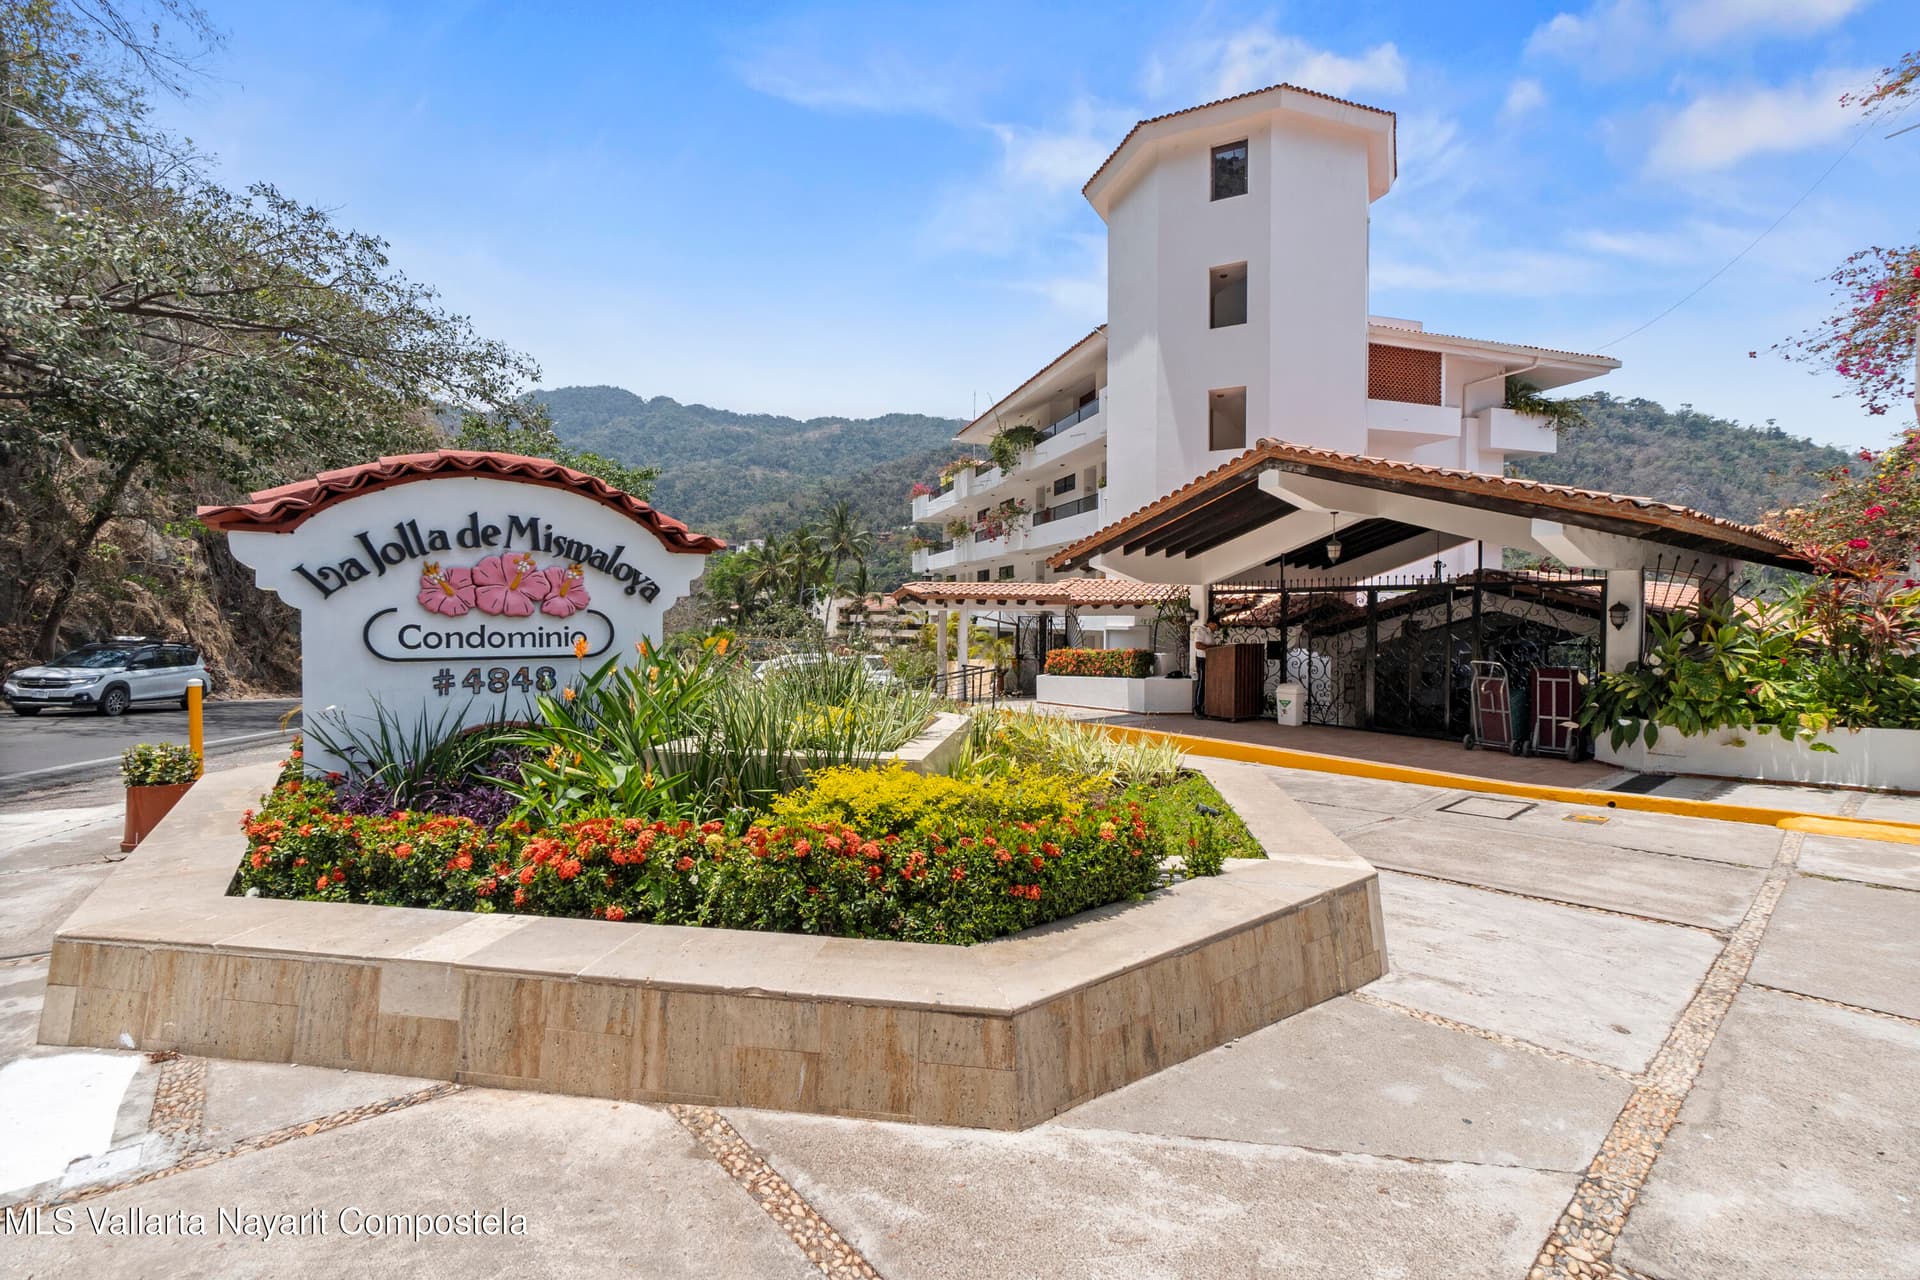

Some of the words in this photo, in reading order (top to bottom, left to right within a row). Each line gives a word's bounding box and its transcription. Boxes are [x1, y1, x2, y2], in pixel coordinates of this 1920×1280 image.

[292, 556, 370, 599] La
[354, 518, 452, 576] Jolla
[457, 512, 502, 549] de
[503, 515, 662, 604] Mismaloya
[398, 624, 588, 651] Condominio
